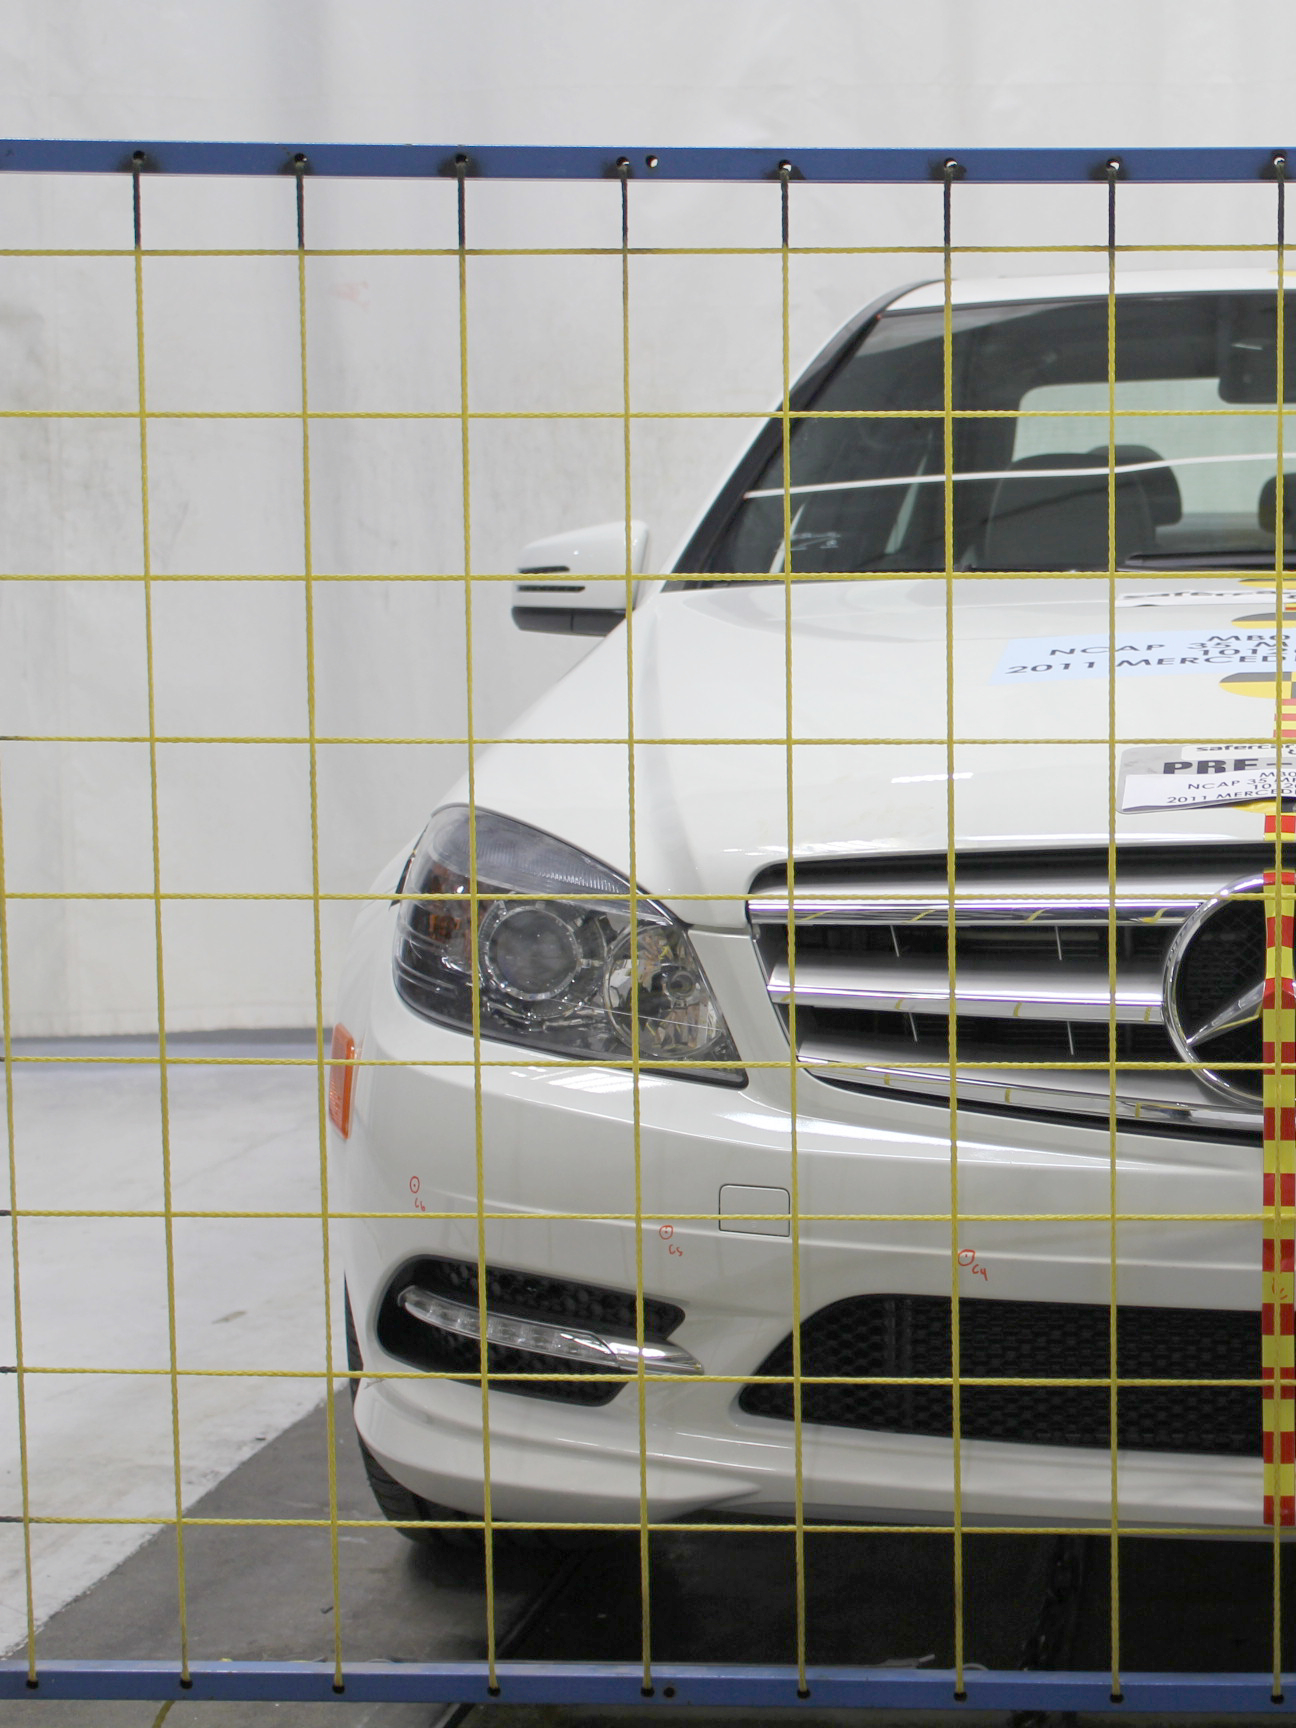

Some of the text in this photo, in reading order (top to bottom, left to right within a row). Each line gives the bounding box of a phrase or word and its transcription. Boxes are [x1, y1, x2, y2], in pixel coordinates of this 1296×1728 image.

[1049, 644, 1166, 656] NCAP
[1005, 661, 1095, 674] 2011
[1188, 780, 1240, 790] NCAP
[1167, 795, 1207, 804] 2011
